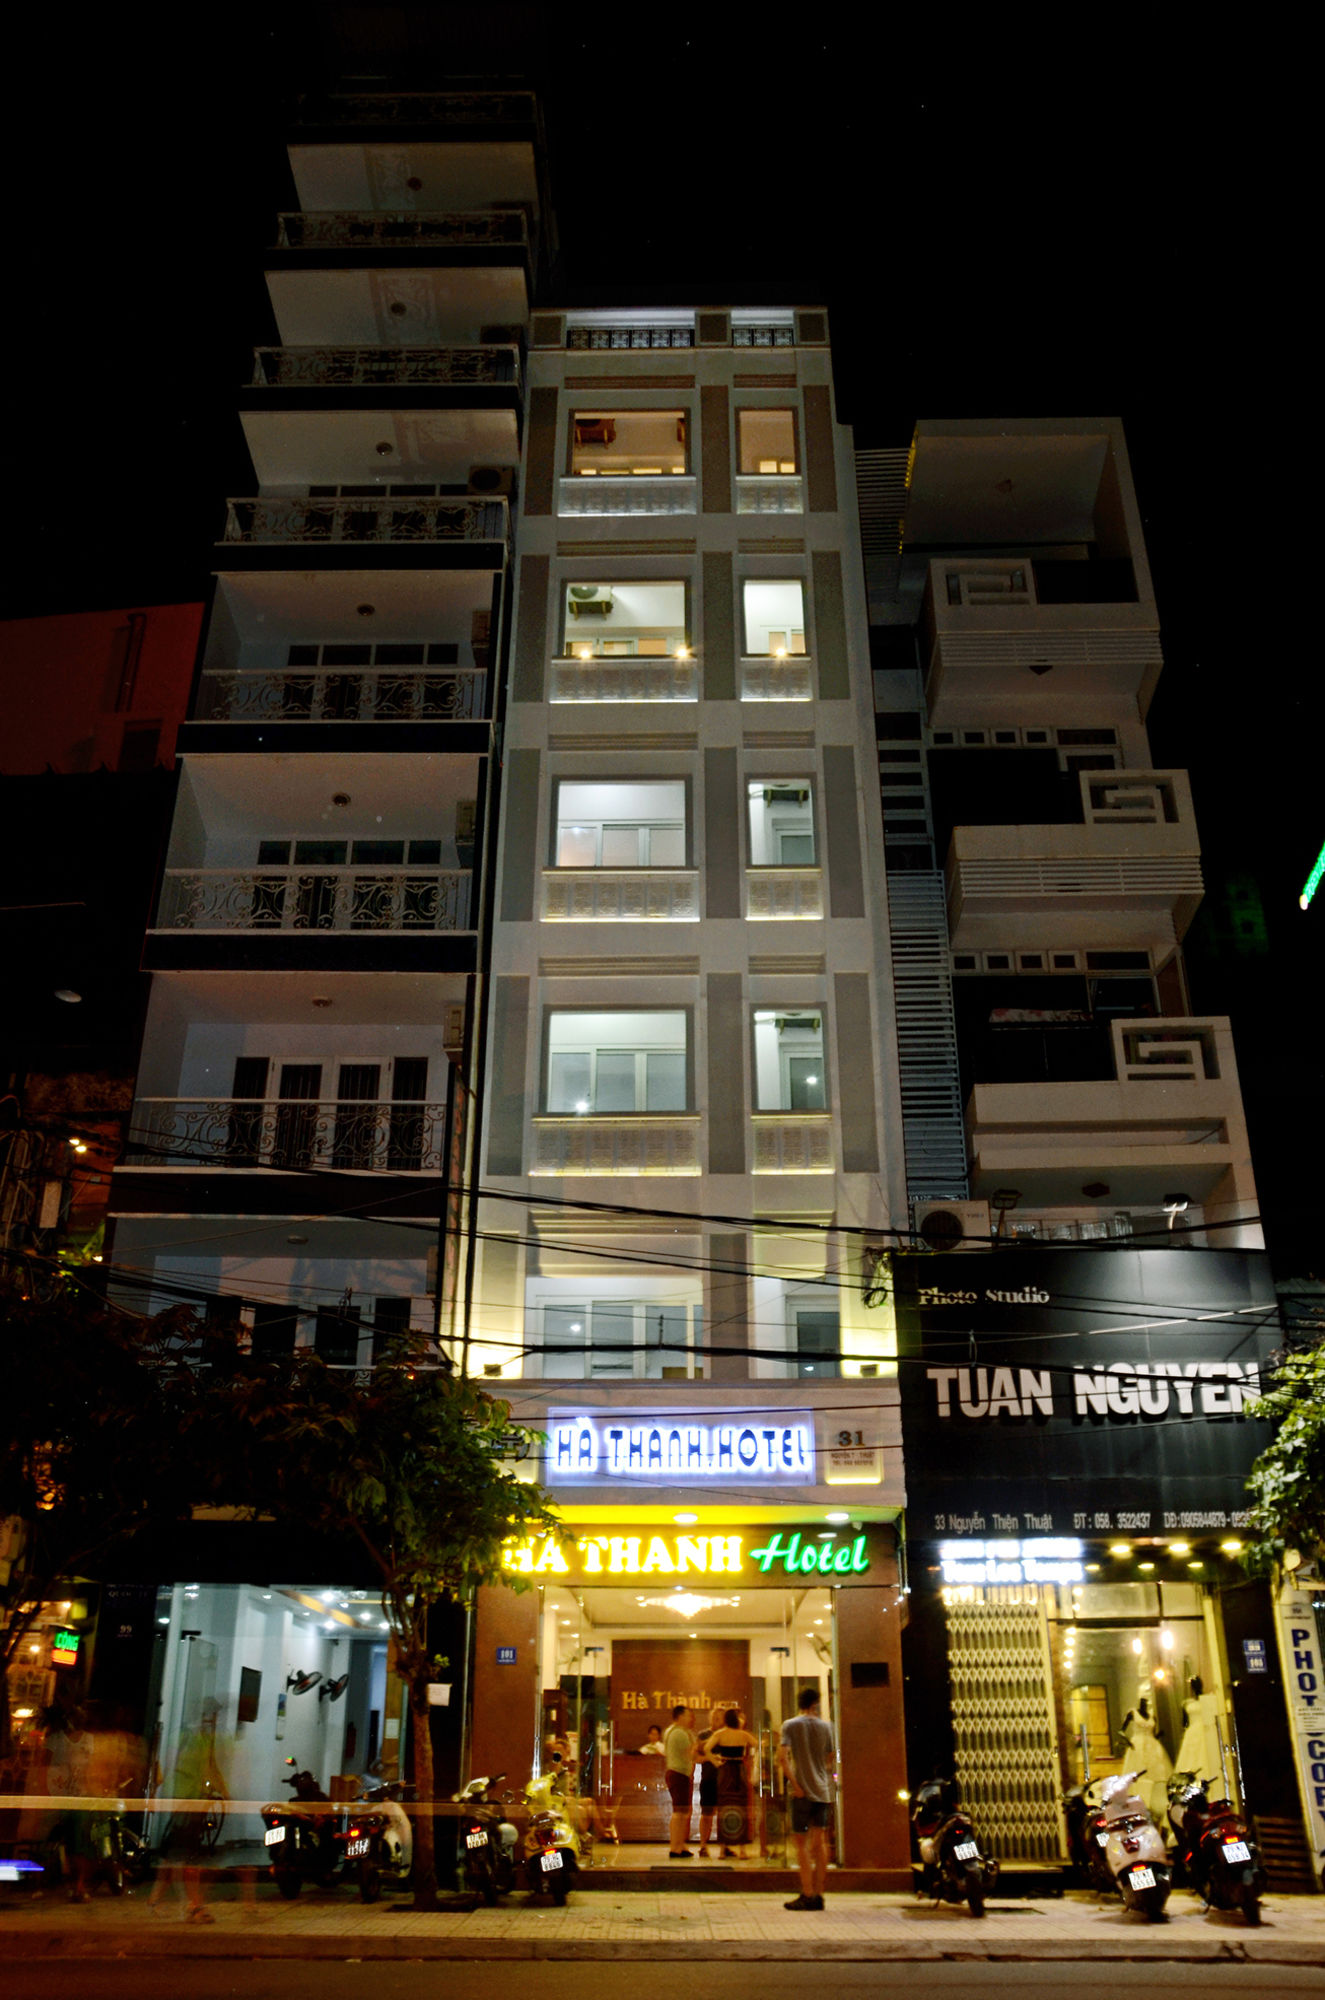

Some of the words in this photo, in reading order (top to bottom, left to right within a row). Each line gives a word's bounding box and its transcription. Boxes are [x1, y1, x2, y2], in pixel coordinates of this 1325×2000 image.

[918, 1286, 978, 1305] Photo
[985, 1286, 1050, 1304] Studio
[927, 1367, 1054, 1417] TUAN
[839, 1430, 866, 1447] 31
[935, 1515, 946, 1530] 33
[576, 1536, 743, 1573] THANH
[749, 1532, 869, 1573] Hotel
